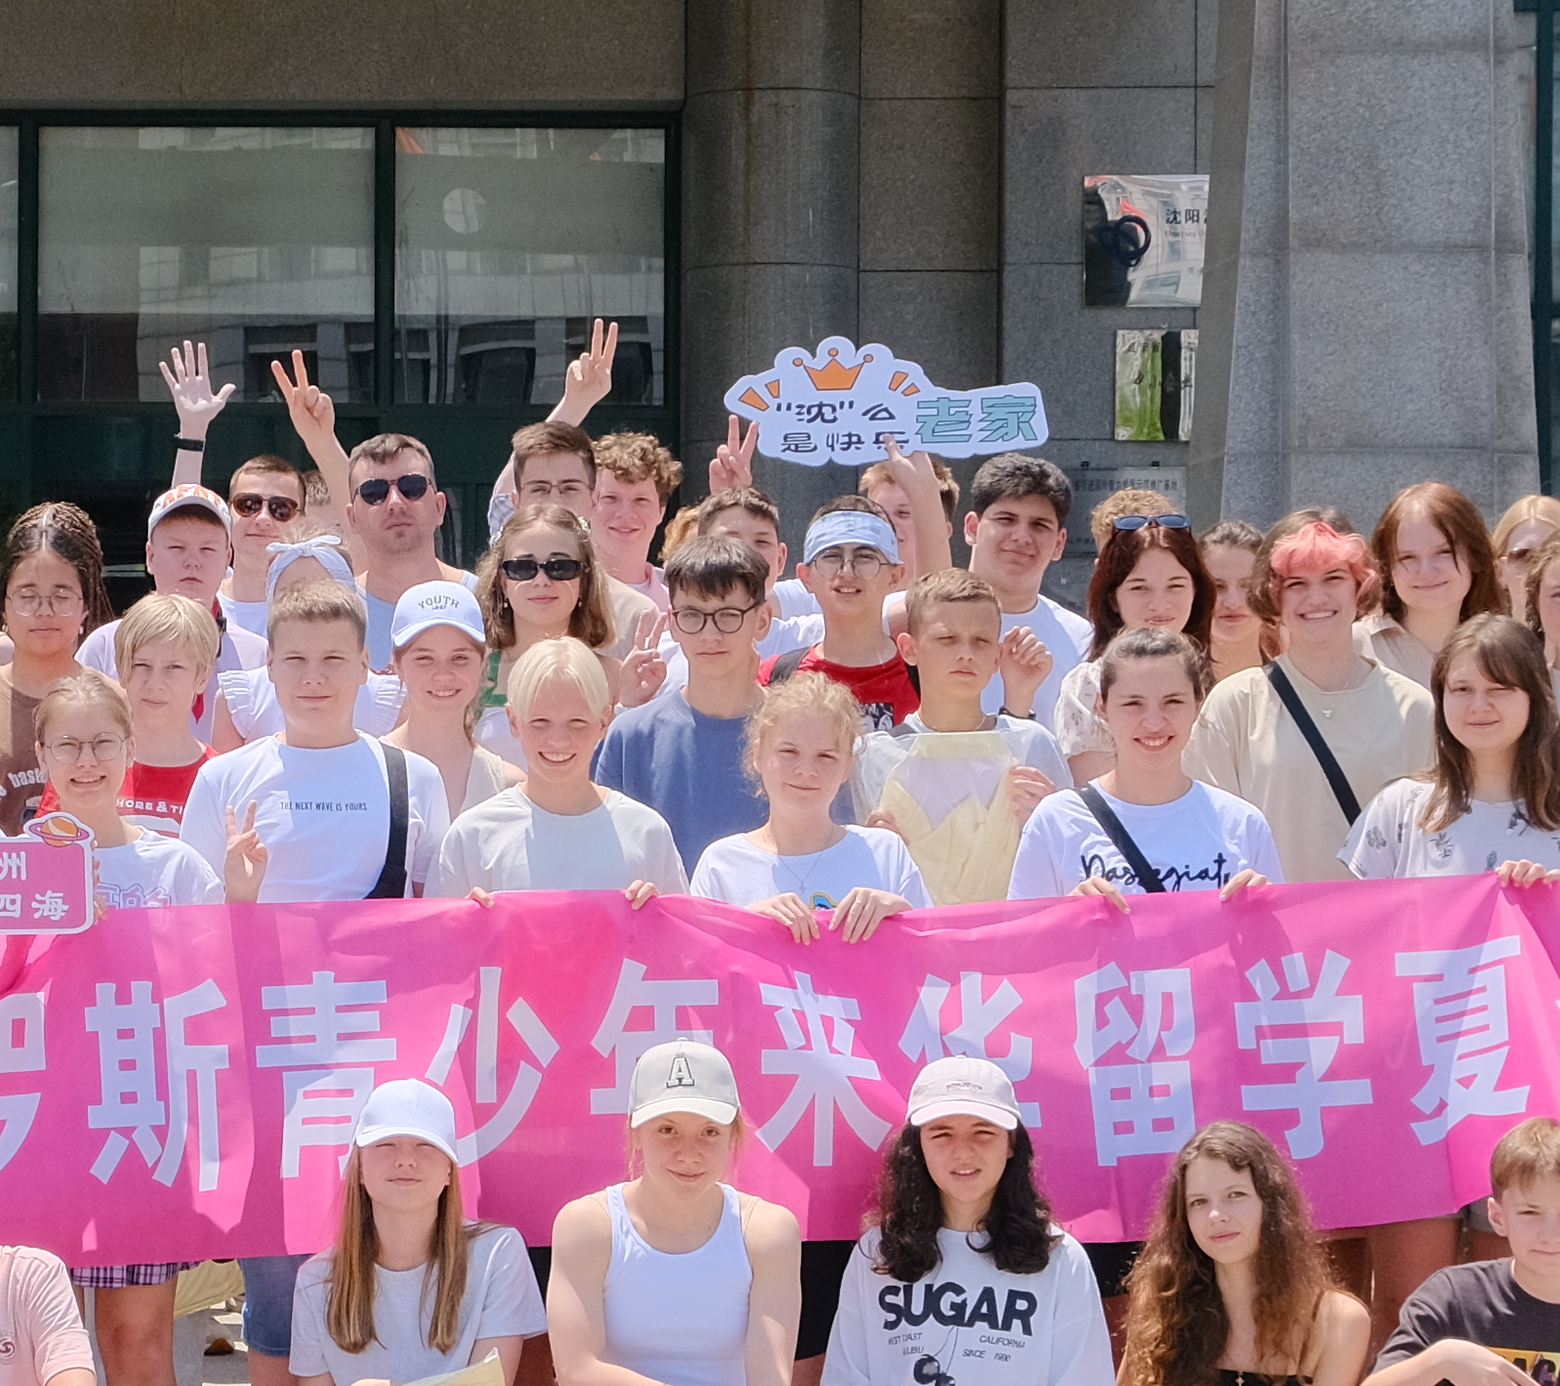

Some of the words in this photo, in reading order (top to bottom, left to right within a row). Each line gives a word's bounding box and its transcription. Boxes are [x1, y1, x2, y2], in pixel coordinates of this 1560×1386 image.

[915, 395, 1039, 444] 老家
[781, 431, 910, 453] 是快乐
[418, 594, 460, 610] YOUTH
[281, 801, 293, 811] THE
[295, 801, 313, 811] NEXT
[315, 801, 334, 812] WAVE
[336, 802, 343, 812] IS
[345, 802, 368, 812] YOURS
[666, 1056, 695, 1089] A
[877, 1281, 1038, 1337] SUGAR
